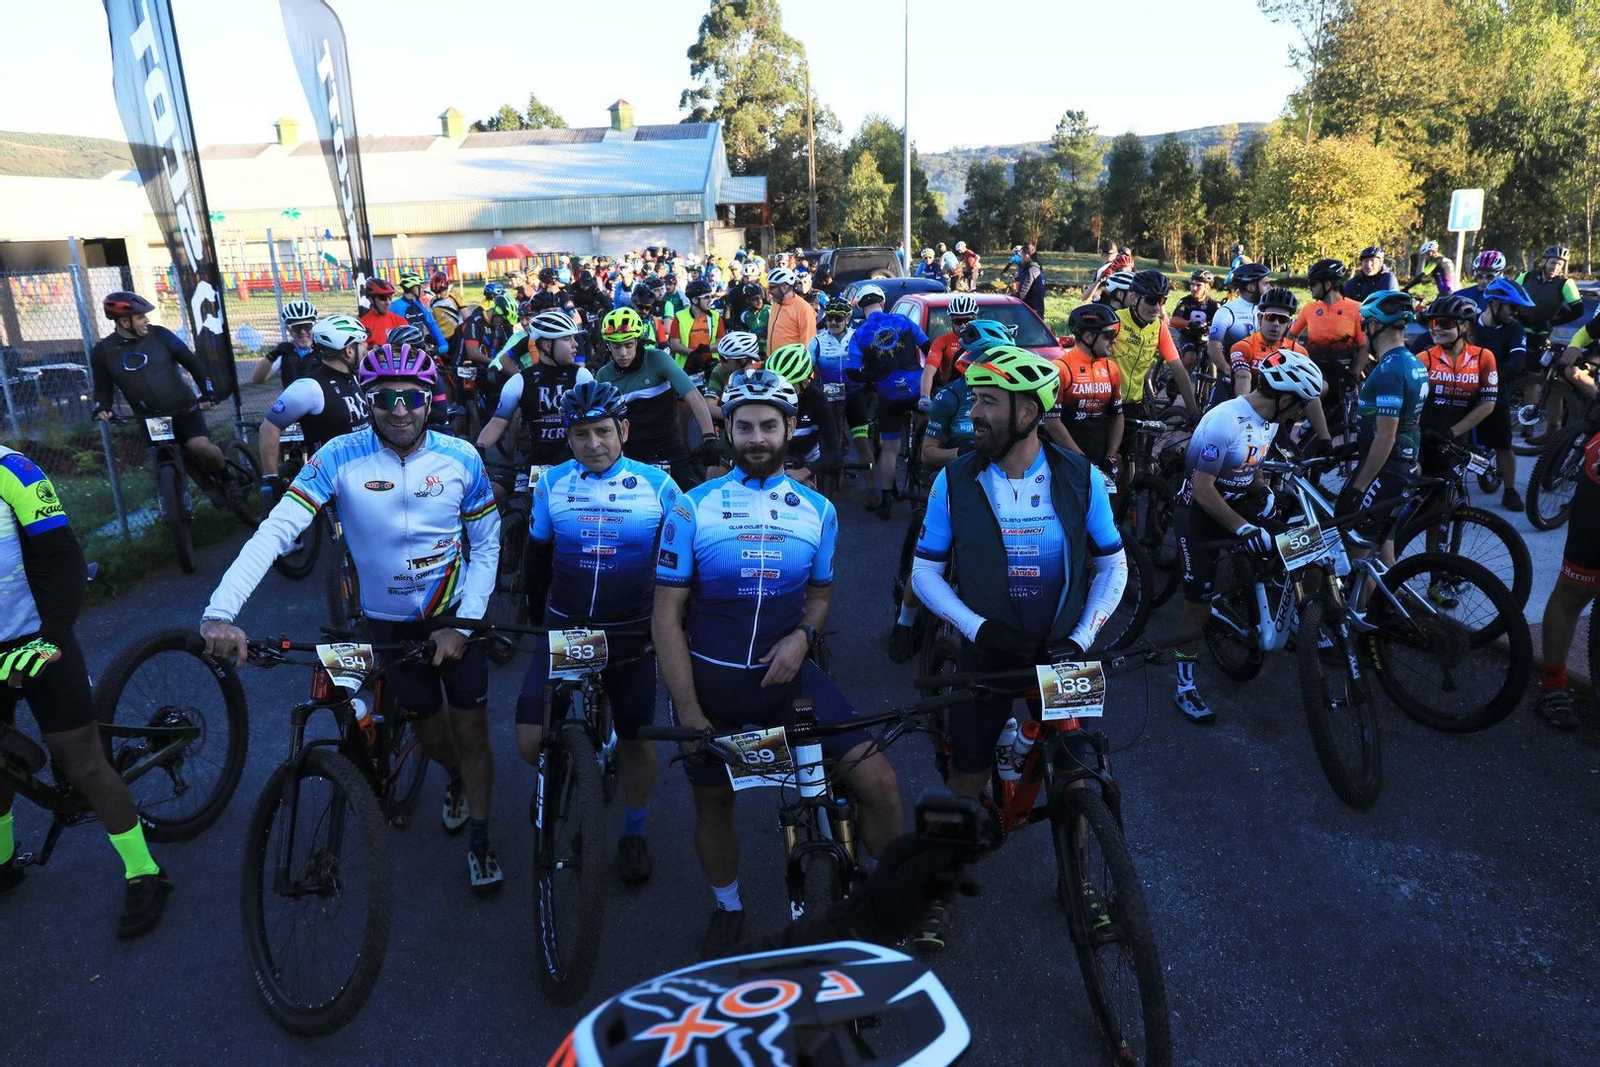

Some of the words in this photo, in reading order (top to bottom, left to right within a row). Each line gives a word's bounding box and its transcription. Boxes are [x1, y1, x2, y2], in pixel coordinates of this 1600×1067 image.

[1289, 534, 1310, 550] 50
[563, 645, 595, 661] 133
[335, 655, 366, 670] 134
[1053, 677, 1092, 694] 138
[737, 748, 775, 764] 139
[632, 968, 866, 1067] FOX
